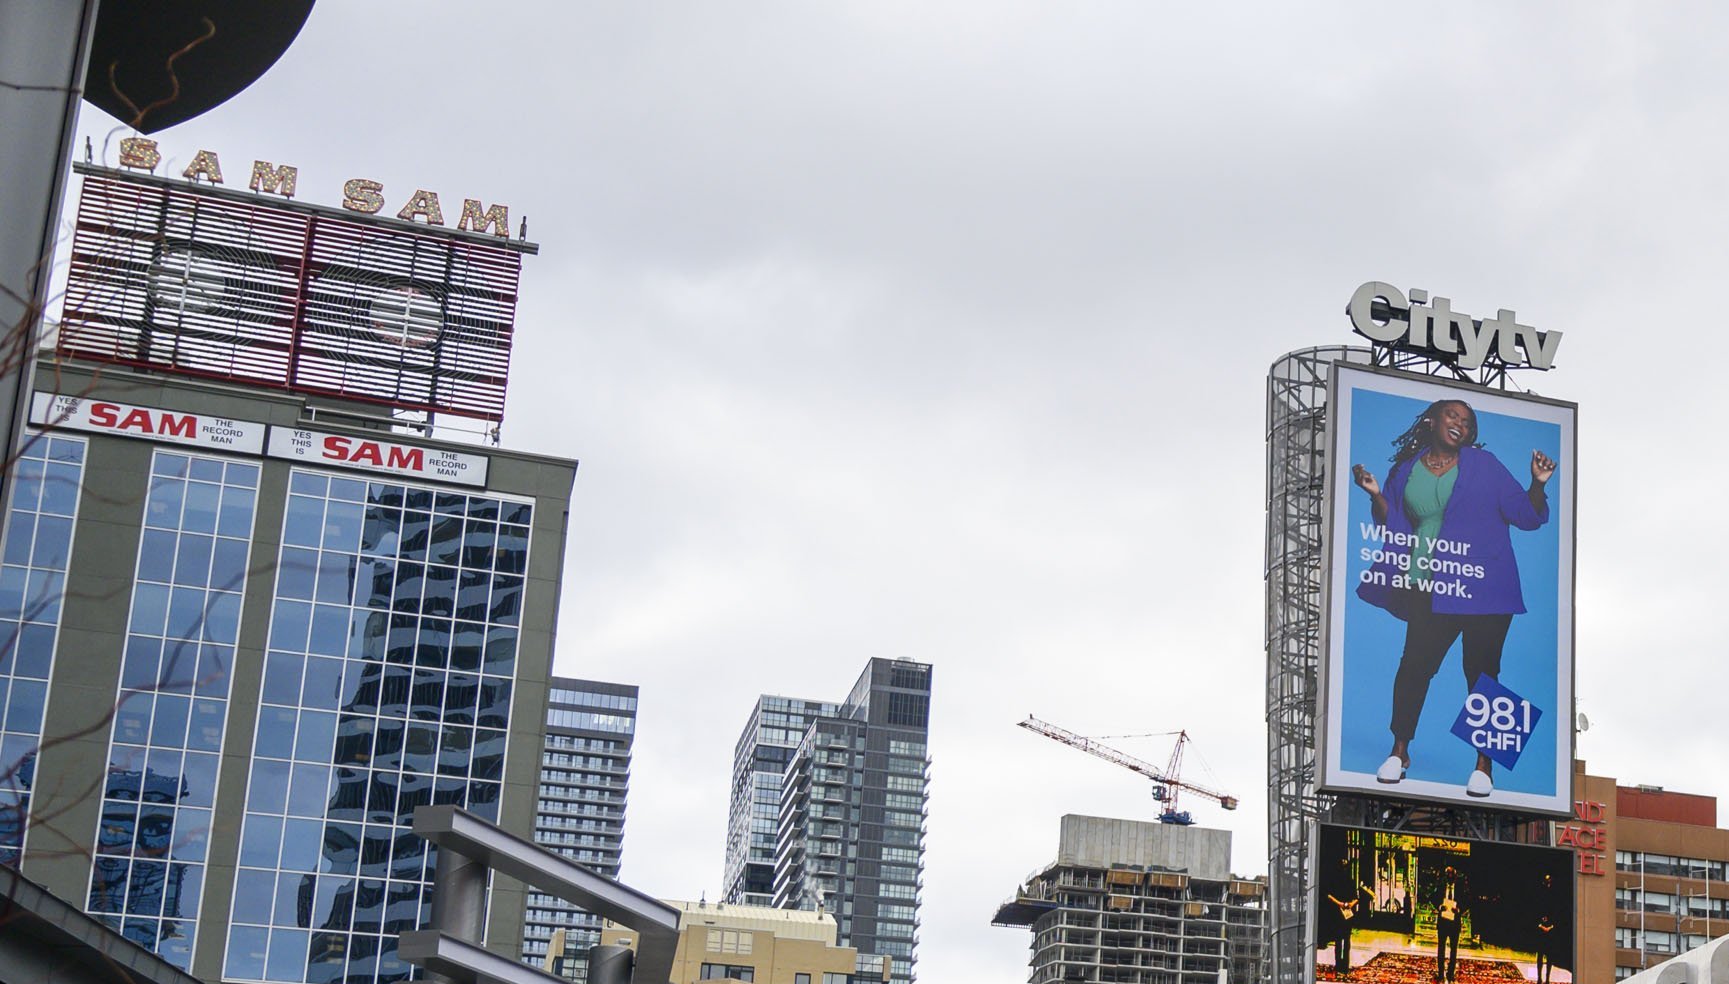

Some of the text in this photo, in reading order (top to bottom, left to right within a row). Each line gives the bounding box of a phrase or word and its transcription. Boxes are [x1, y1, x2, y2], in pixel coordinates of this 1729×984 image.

[118, 137, 511, 238] SAM SAM
[1347, 277, 1564, 372] Citytv
[88, 402, 198, 440] SAM
[214, 418, 234, 428] THE
[202, 425, 244, 438] RECORD
[210, 435, 233, 445] MAN
[293, 430, 312, 440] YES
[291, 438, 312, 448] THIS
[295, 447, 305, 455] IS
[321, 435, 424, 472] SAM
[440, 451, 458, 461] THE
[429, 458, 468, 470] RECORD
[437, 467, 458, 477] MAN
[1360, 522, 1471, 556] When your
[1360, 547, 1485, 579] song comes
[1360, 569, 1473, 599] on at work.
[1465, 693, 1531, 733] 98.1
[1471, 729, 1521, 752] CHFI
